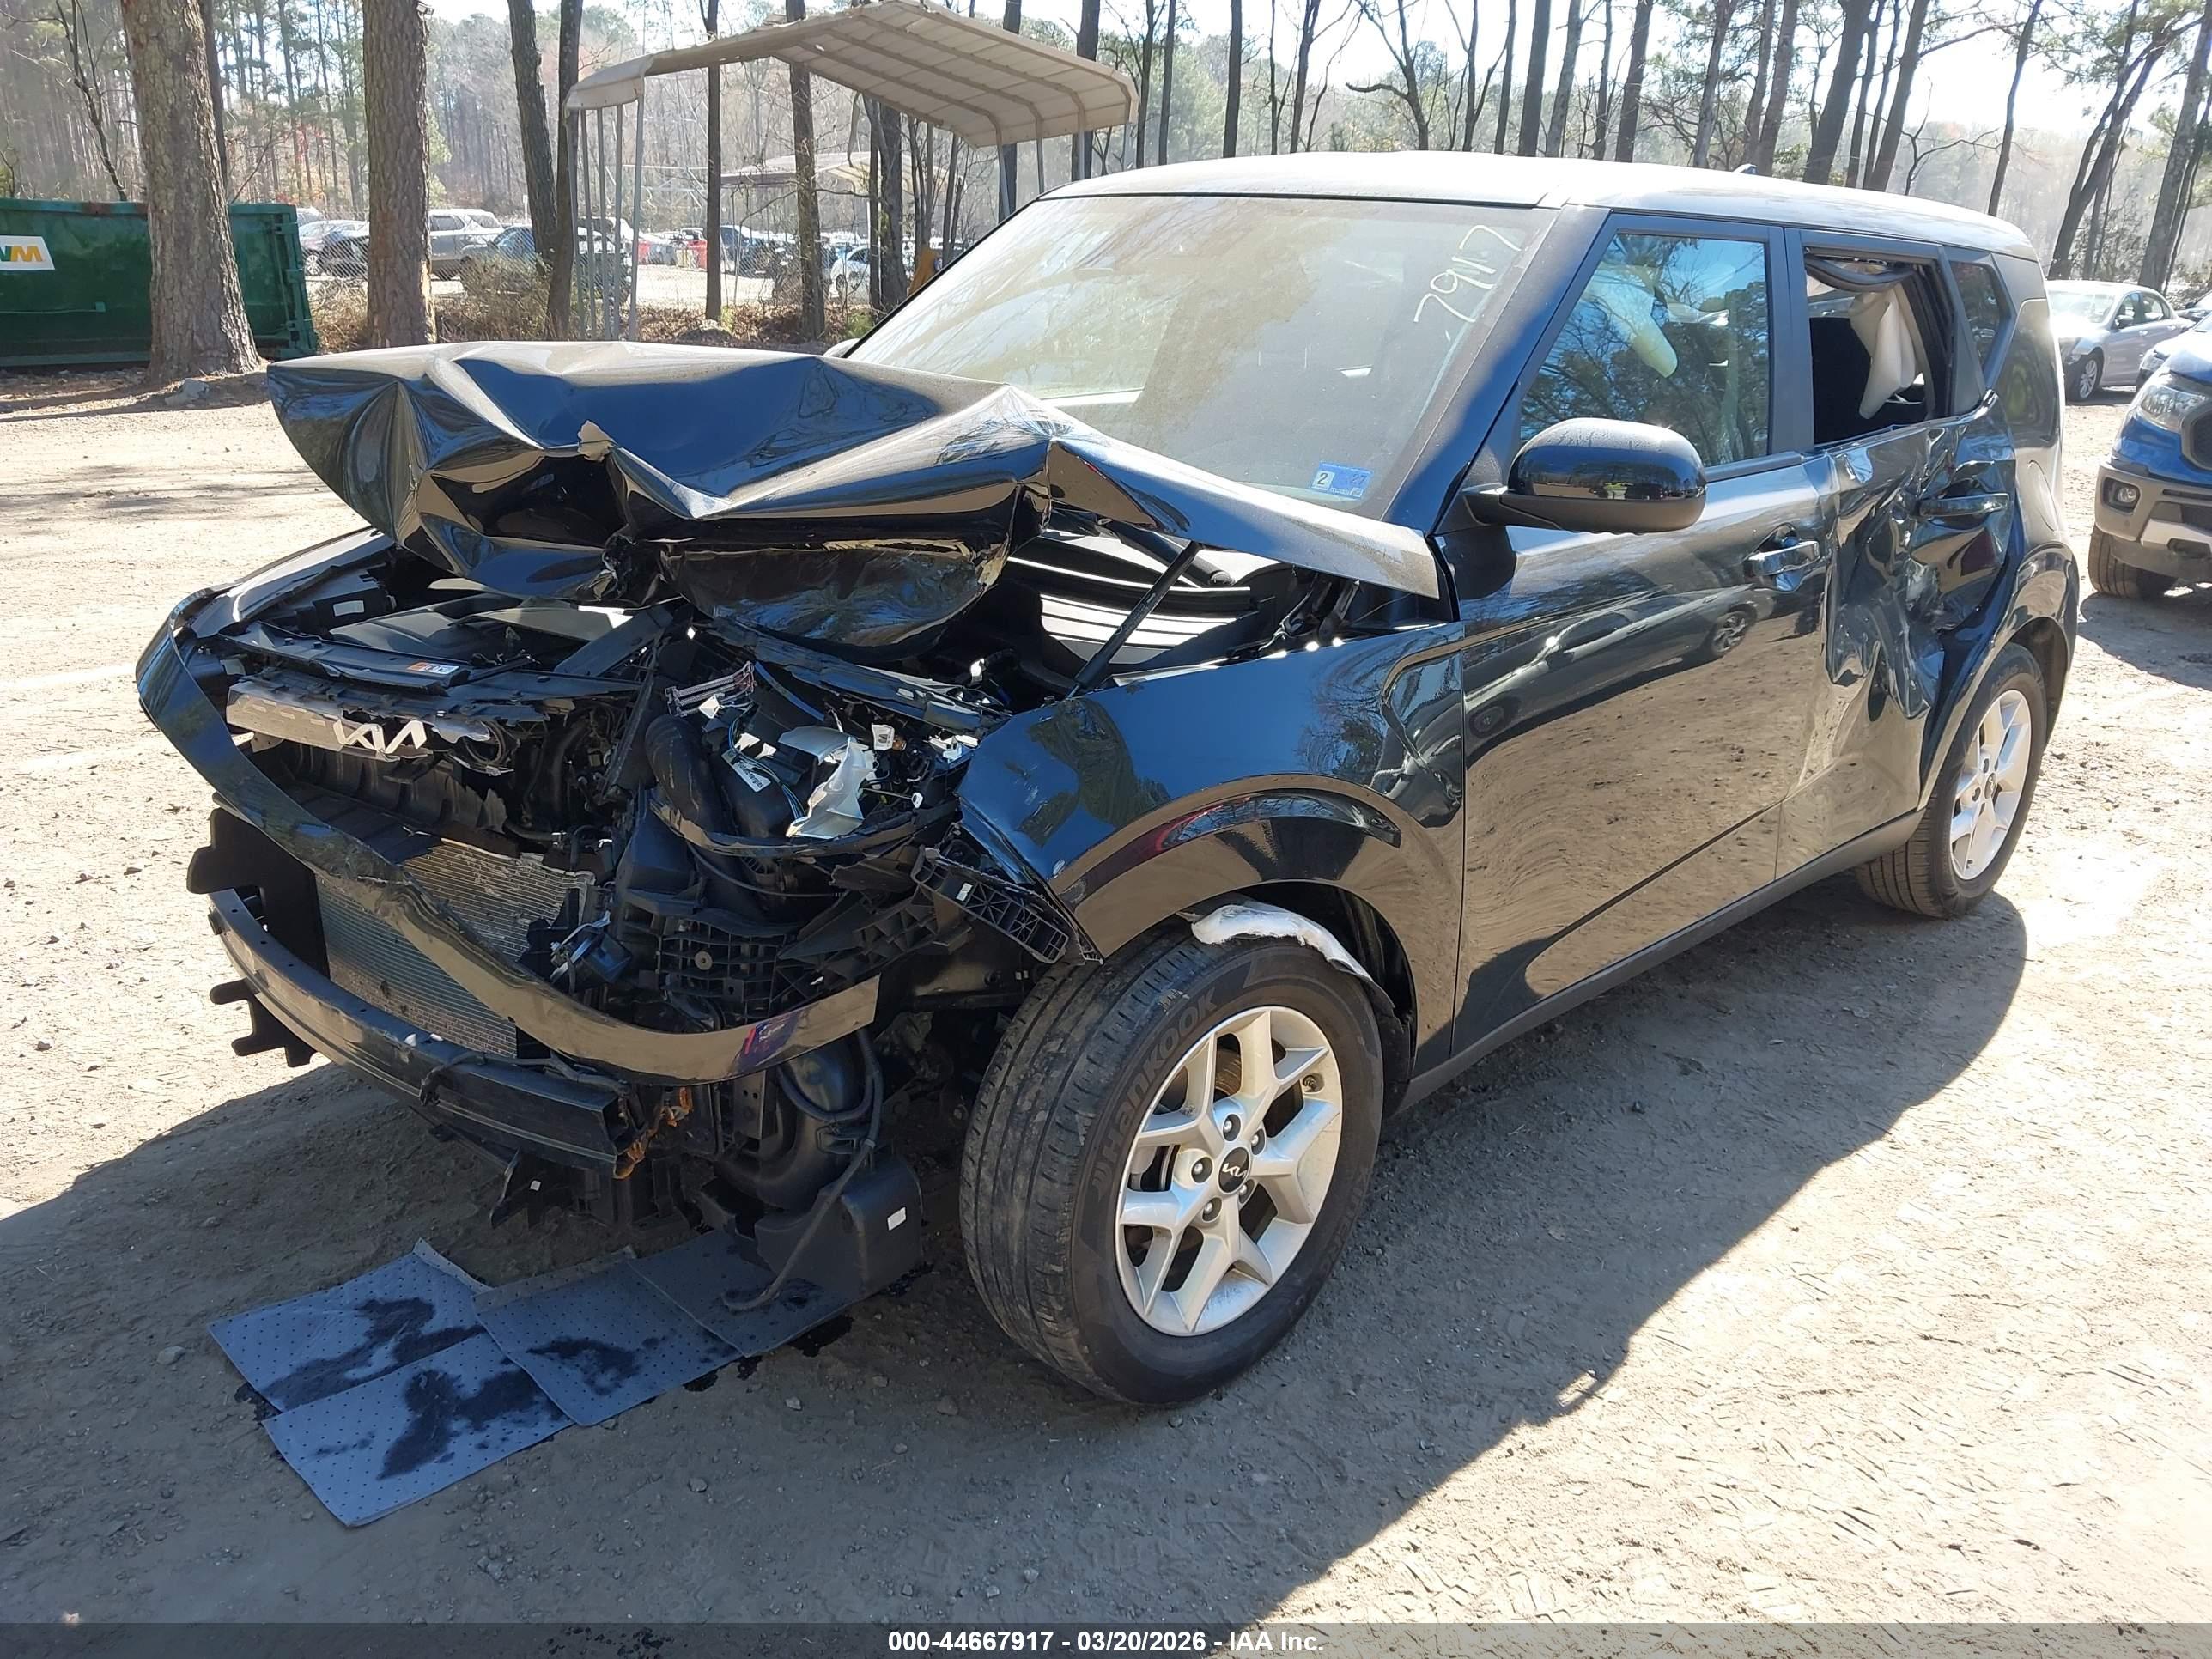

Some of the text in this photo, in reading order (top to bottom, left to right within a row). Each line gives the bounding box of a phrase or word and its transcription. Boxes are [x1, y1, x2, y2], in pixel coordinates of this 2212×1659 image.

[1413, 224, 1522, 323] 7917
[1316, 472, 1328, 485] 2
[332, 718, 428, 755] KIA
